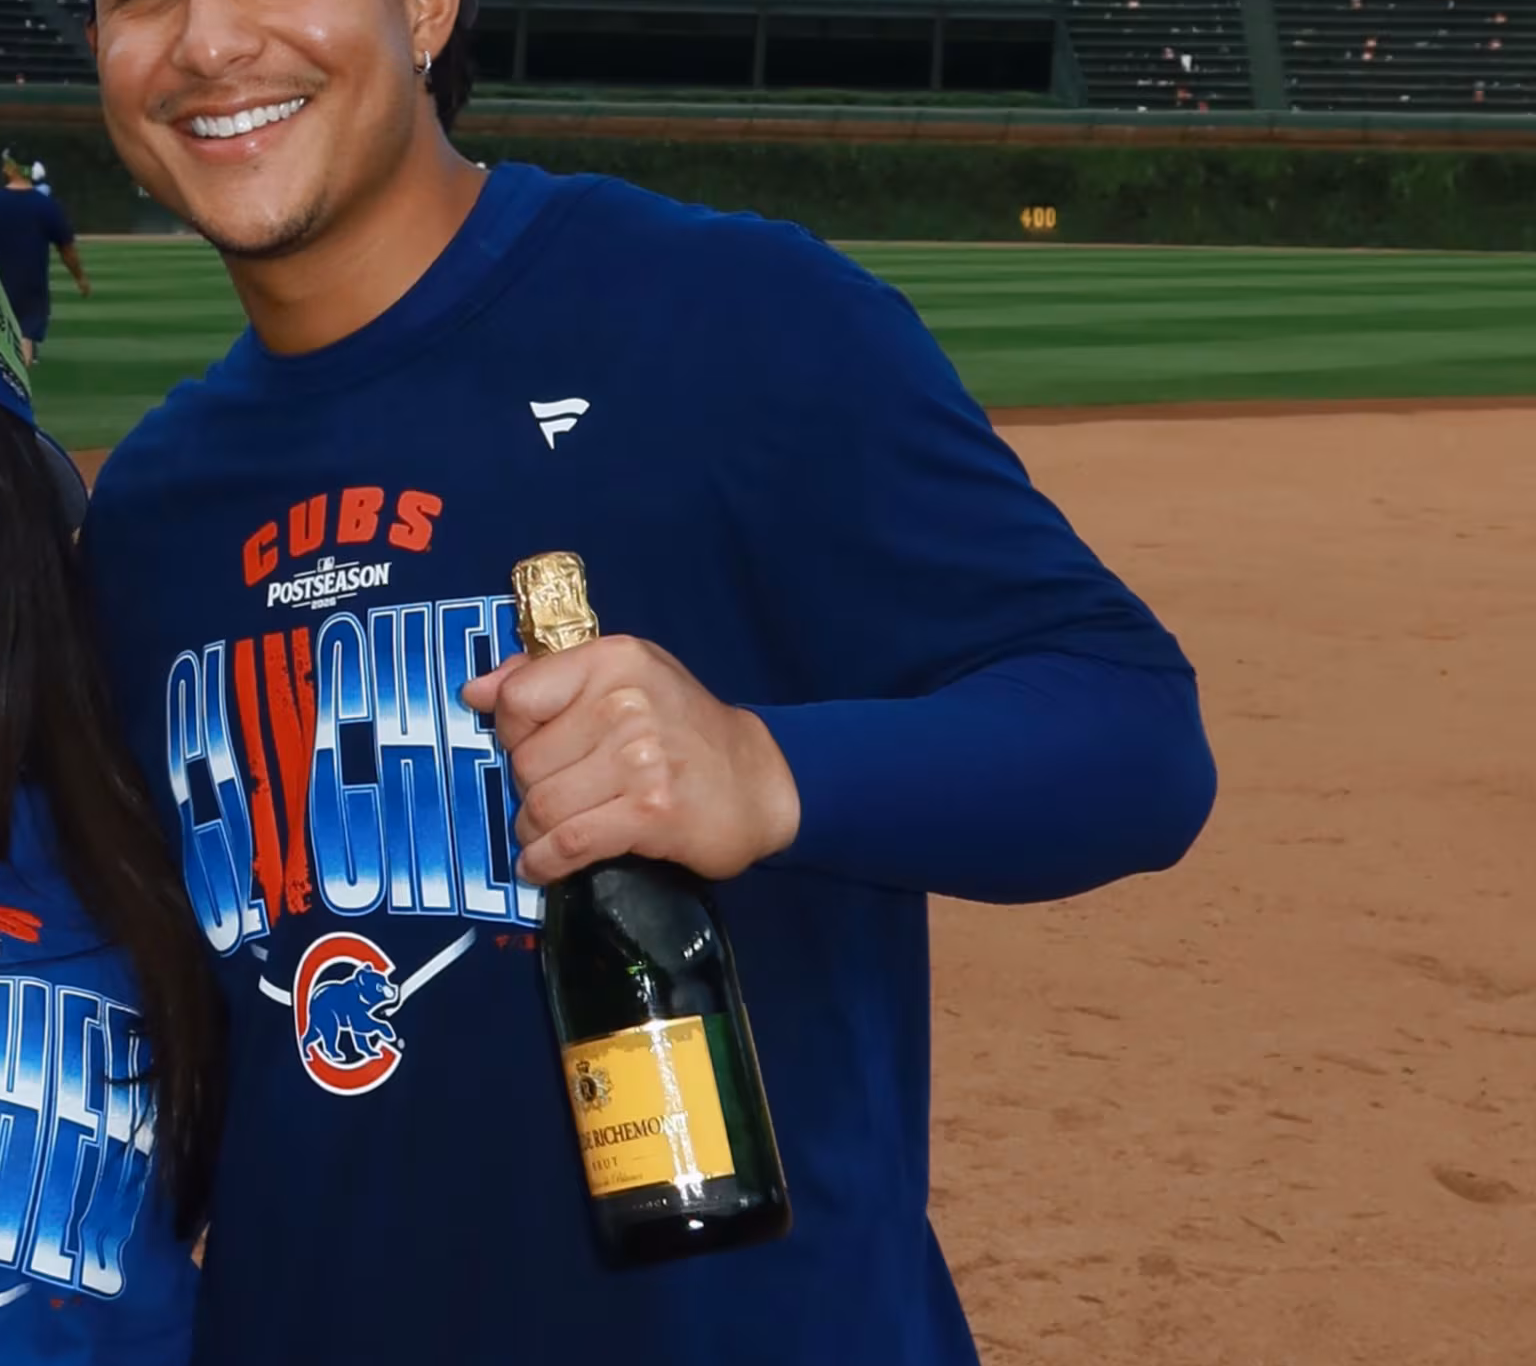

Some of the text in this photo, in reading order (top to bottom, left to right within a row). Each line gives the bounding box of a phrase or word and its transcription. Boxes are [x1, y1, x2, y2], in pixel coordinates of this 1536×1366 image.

[1020, 207, 1056, 227] 400
[242, 486, 443, 587] CUBS
[267, 562, 391, 607] POSTSEASON
